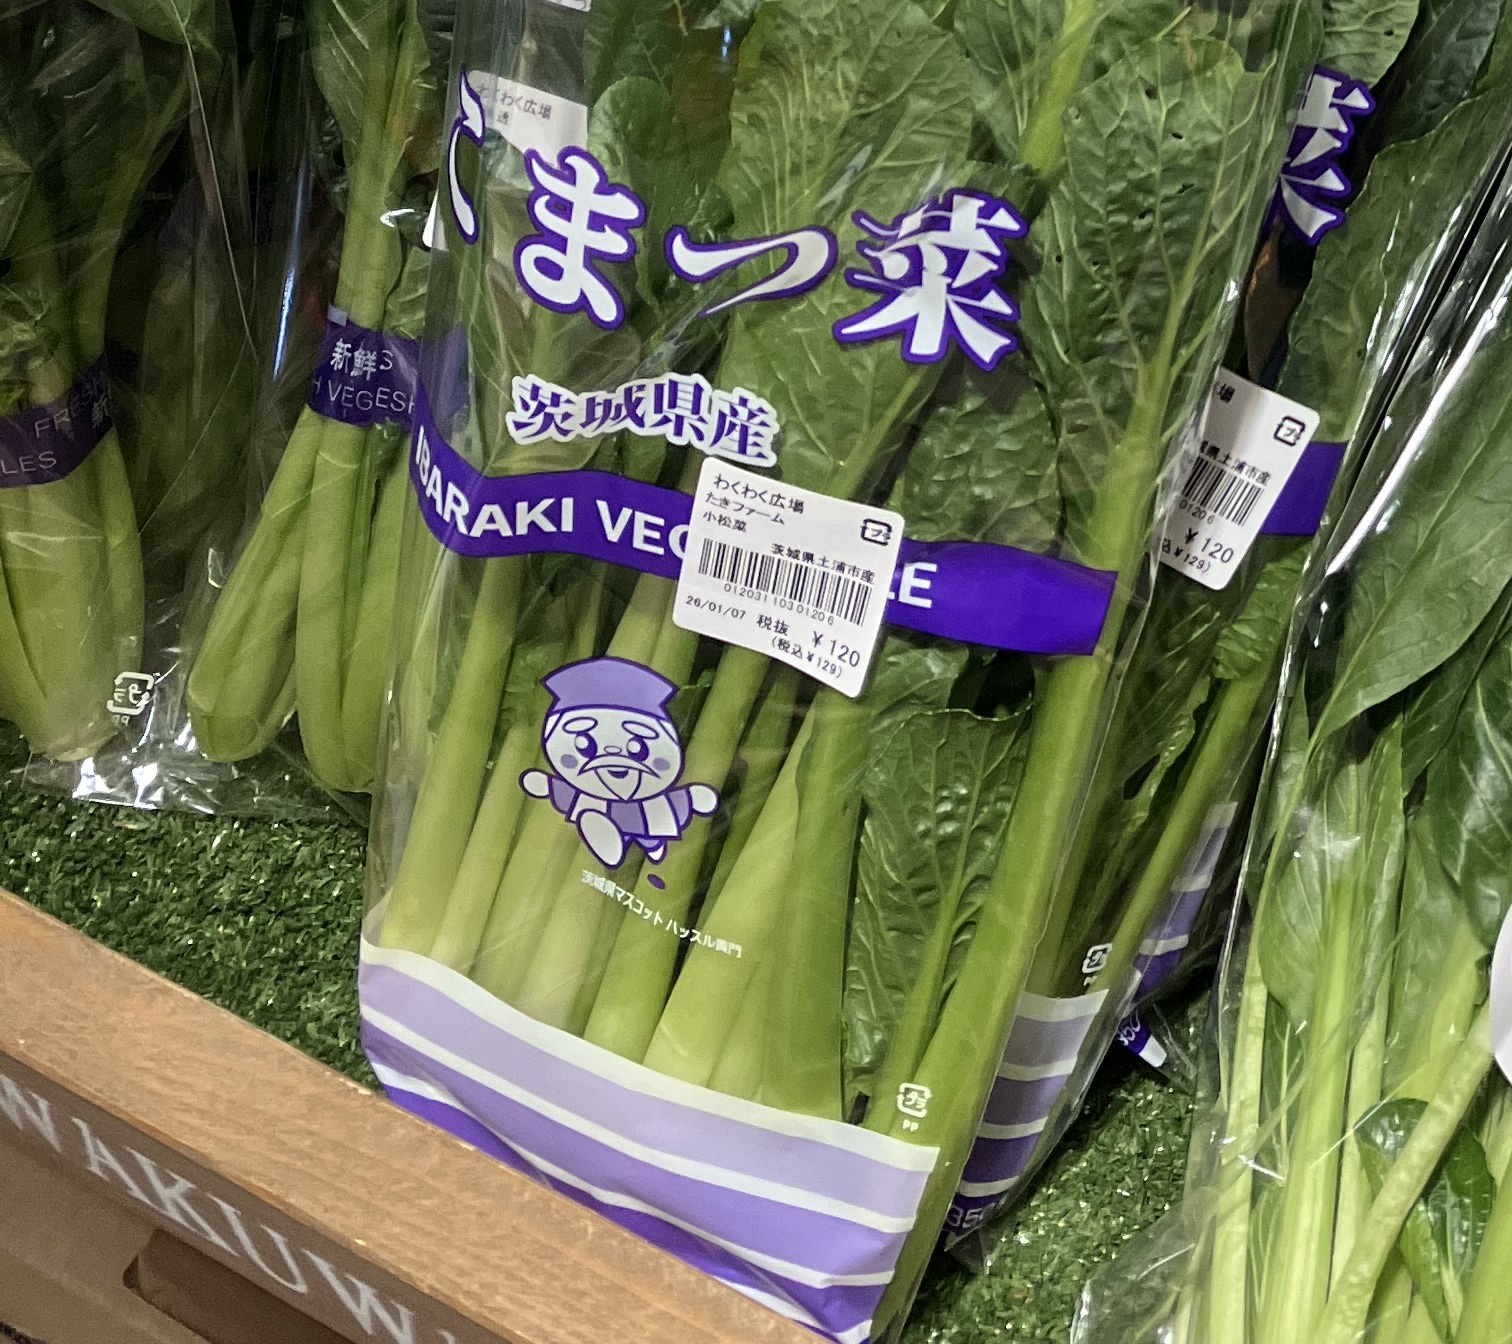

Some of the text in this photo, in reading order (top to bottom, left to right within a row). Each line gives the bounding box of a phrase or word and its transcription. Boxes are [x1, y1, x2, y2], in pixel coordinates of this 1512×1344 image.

[445, 67, 1029, 370] こまつ菜
[511, 373, 778, 467] 茨城県産
[414, 424, 575, 540] IBARAKI
[712, 472, 805, 516] わくわく広場
[702, 510, 748, 534] 小松菜
[704, 491, 786, 526] たきファーム
[770, 542, 876, 586] 茨城県土浦市産
[723, 581, 768, 605] 012031
[684, 594, 747, 620] 26/01/07
[755, 613, 790, 637] 税抜
[771, 636, 843, 679] (税込¥129)
[0, 1073, 464, 1344] WAKUW
